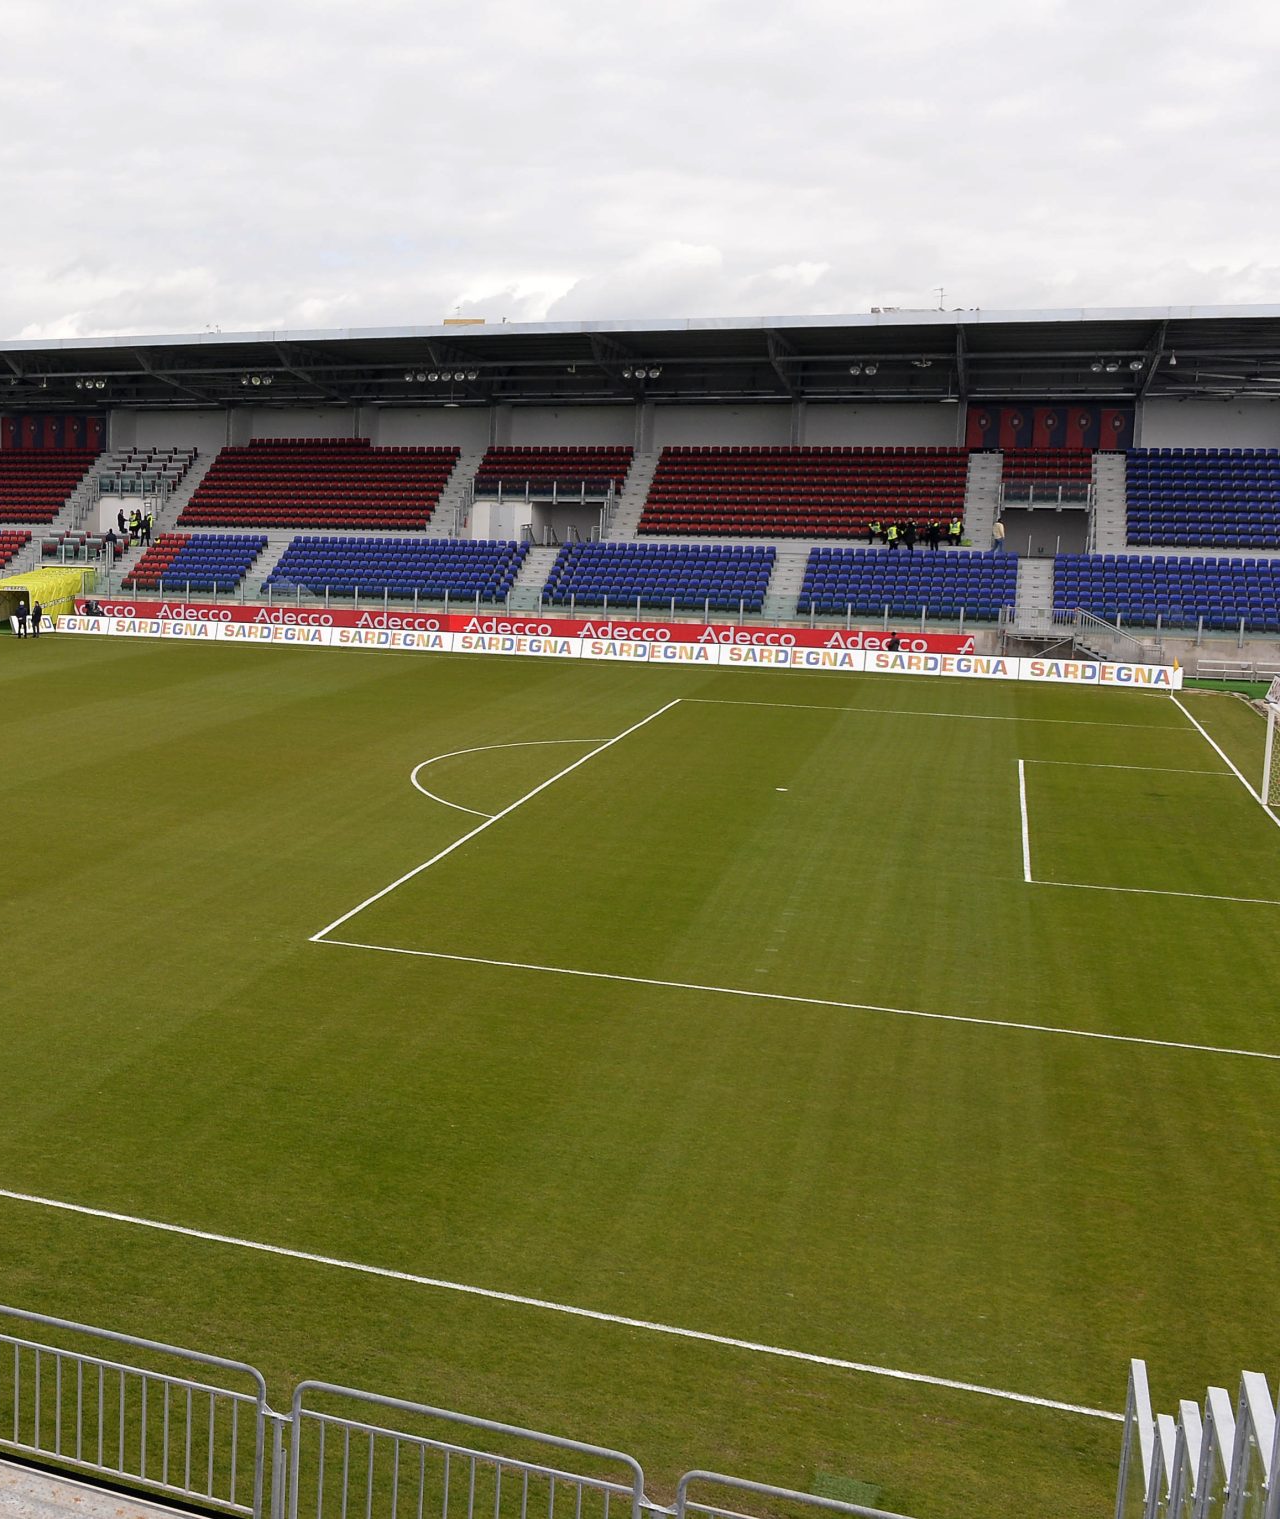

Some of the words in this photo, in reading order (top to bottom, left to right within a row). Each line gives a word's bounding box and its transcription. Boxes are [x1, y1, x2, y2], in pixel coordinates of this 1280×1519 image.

[115, 618, 209, 636] SARDEGNA
[156, 604, 232, 621] Adecco
[254, 608, 333, 626] Adecco
[355, 612, 440, 631] Adecco
[463, 617, 552, 636] Adecco
[577, 622, 671, 642] Adecco
[697, 626, 796, 646] Adecco
[224, 624, 322, 642] SARDEGNA
[339, 629, 443, 648] SARDEGNA
[461, 635, 571, 654] SARDEGNA
[591, 641, 709, 660] SARDEGNA
[729, 647, 854, 667] SARDEGNA
[875, 653, 1007, 675] SARDEGNA
[1030, 661, 1170, 685] SARDEGNA
